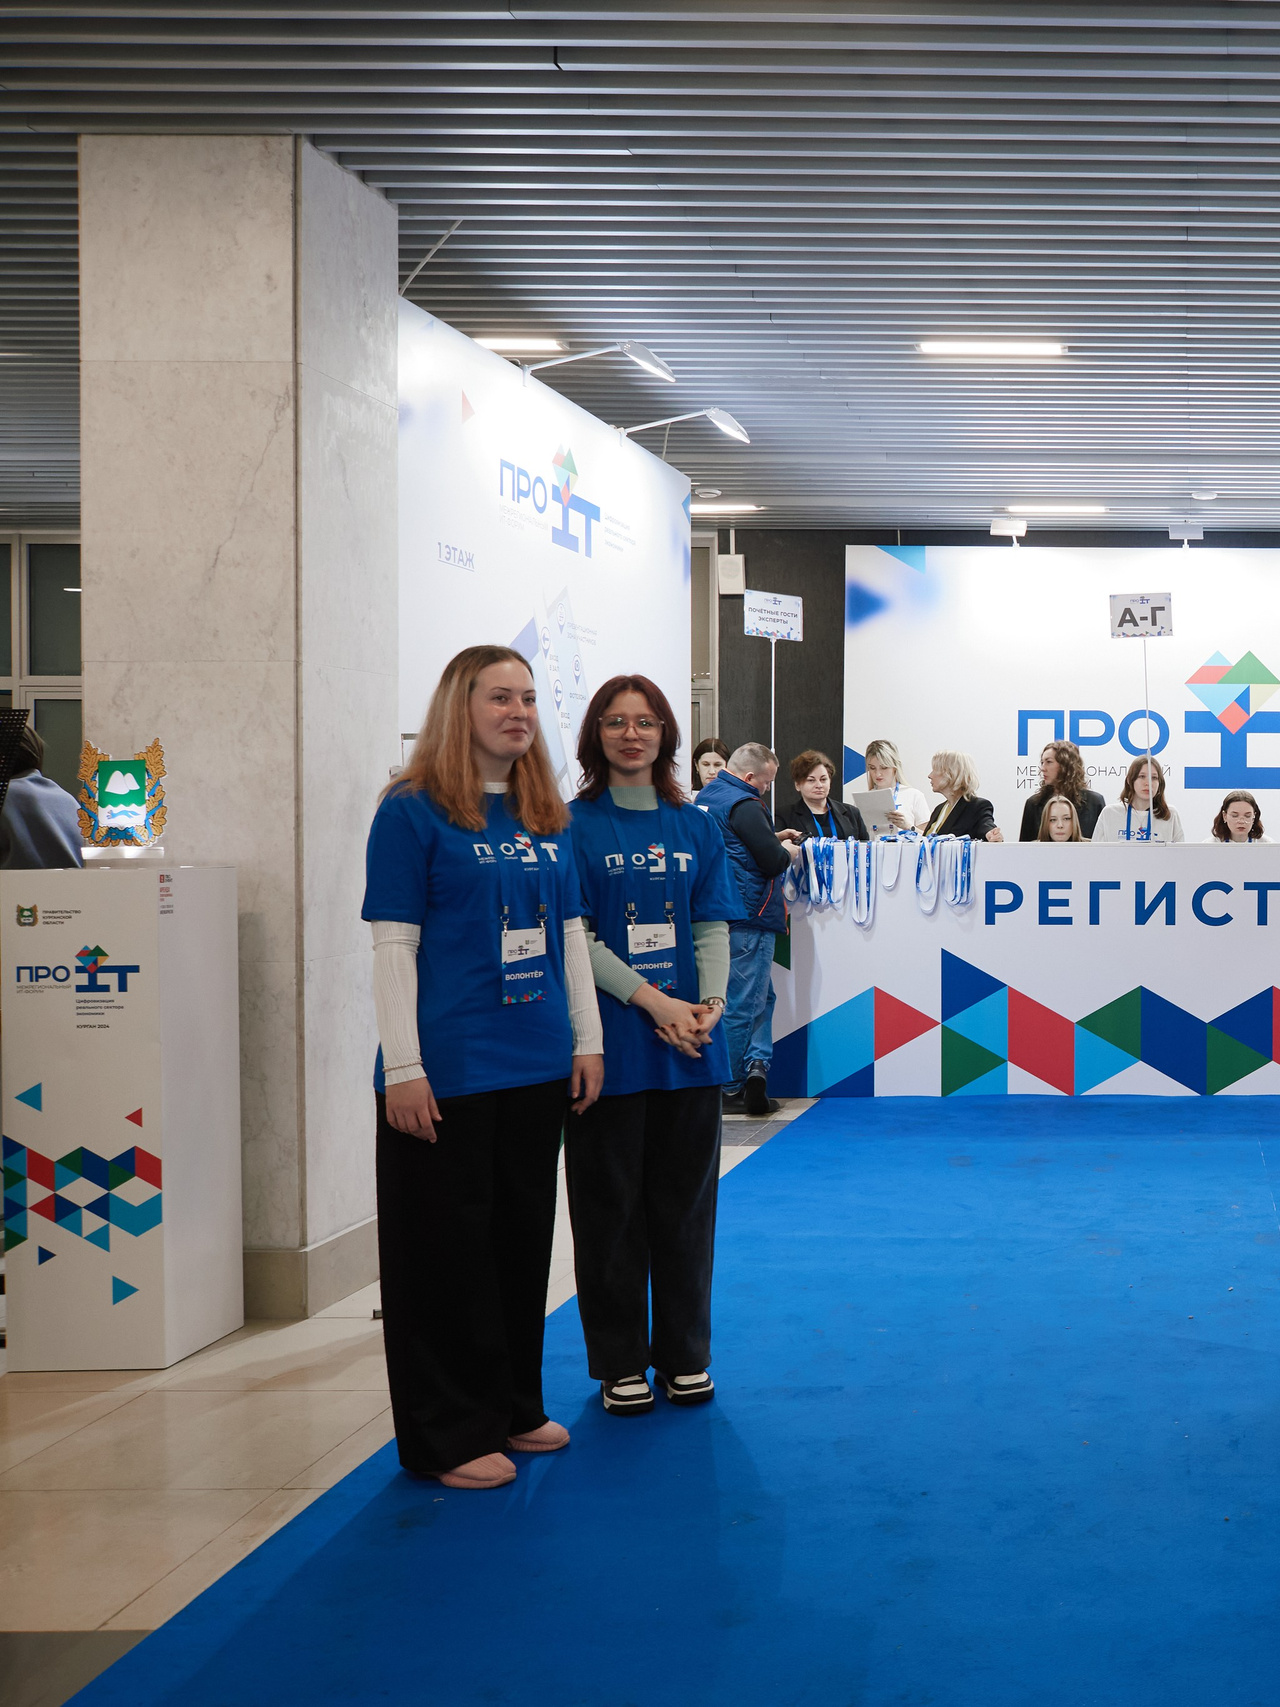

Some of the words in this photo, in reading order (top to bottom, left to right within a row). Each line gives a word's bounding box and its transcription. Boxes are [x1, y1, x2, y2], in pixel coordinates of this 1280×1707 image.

[500, 458, 548, 514] ПРО
[437, 542, 442, 558] 1
[444, 544, 475, 569] ЭТАЖ
[758, 616, 788, 624] ЭКСПЕРТЫ
[1117, 606, 1165, 627] А-Г
[1018, 709, 1170, 757] ПРО
[505, 970, 544, 981] ВОЛОНТЁР
[632, 961, 673, 971] ВОЛОНТЁР
[16, 965, 71, 982] ПРО
[75, 965, 140, 992] IT
